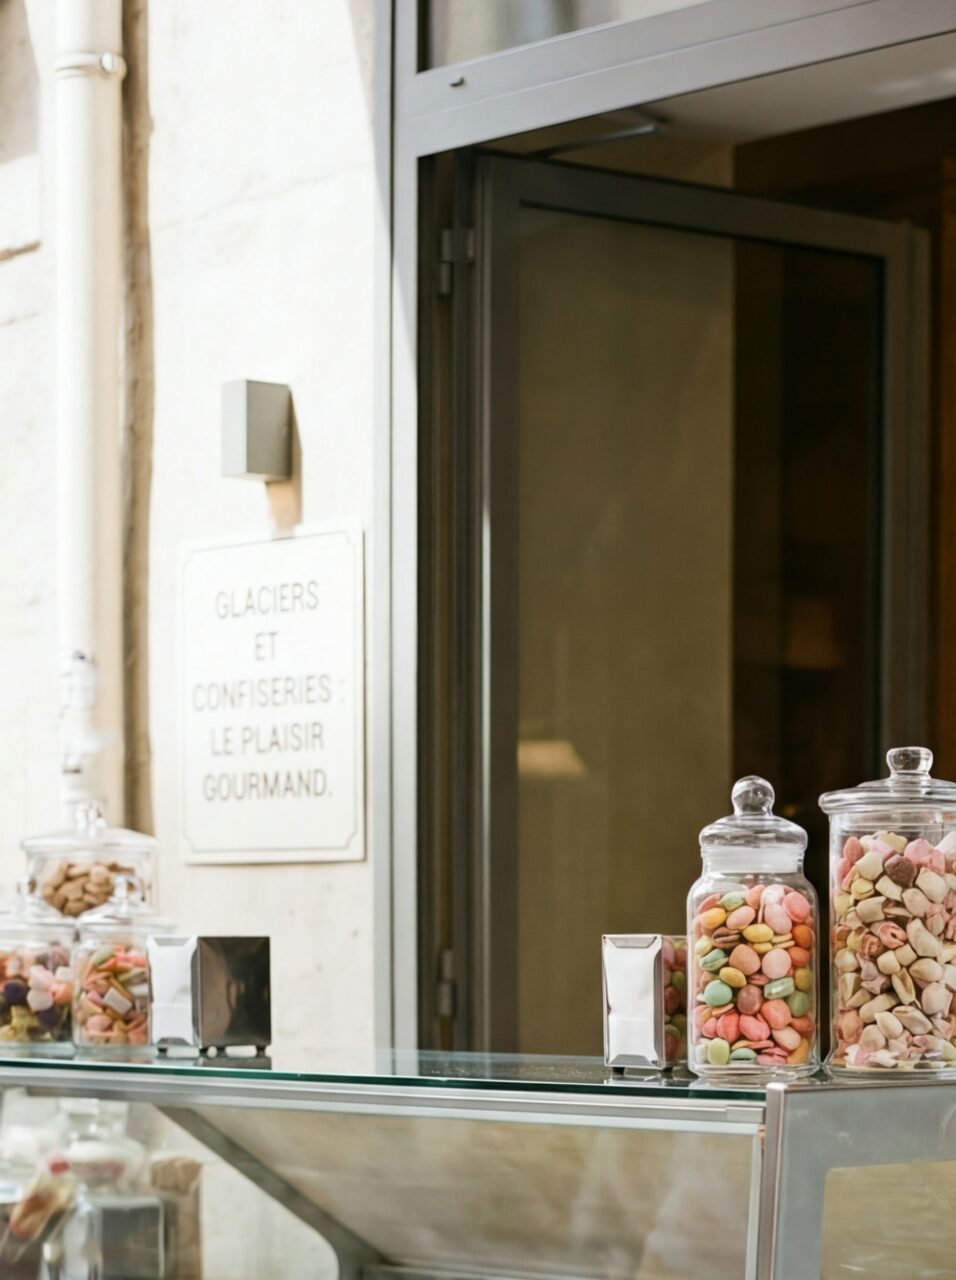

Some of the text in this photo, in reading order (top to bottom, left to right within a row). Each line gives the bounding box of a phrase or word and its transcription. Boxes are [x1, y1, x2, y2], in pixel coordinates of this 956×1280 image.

[215, 580, 319, 619] GLACIERS
[254, 631, 279, 661] ET
[192, 674, 332, 712] CONFISERIES
[210, 721, 325, 757] LE PLAISIR
[203, 768, 333, 803] GOURMAND.
